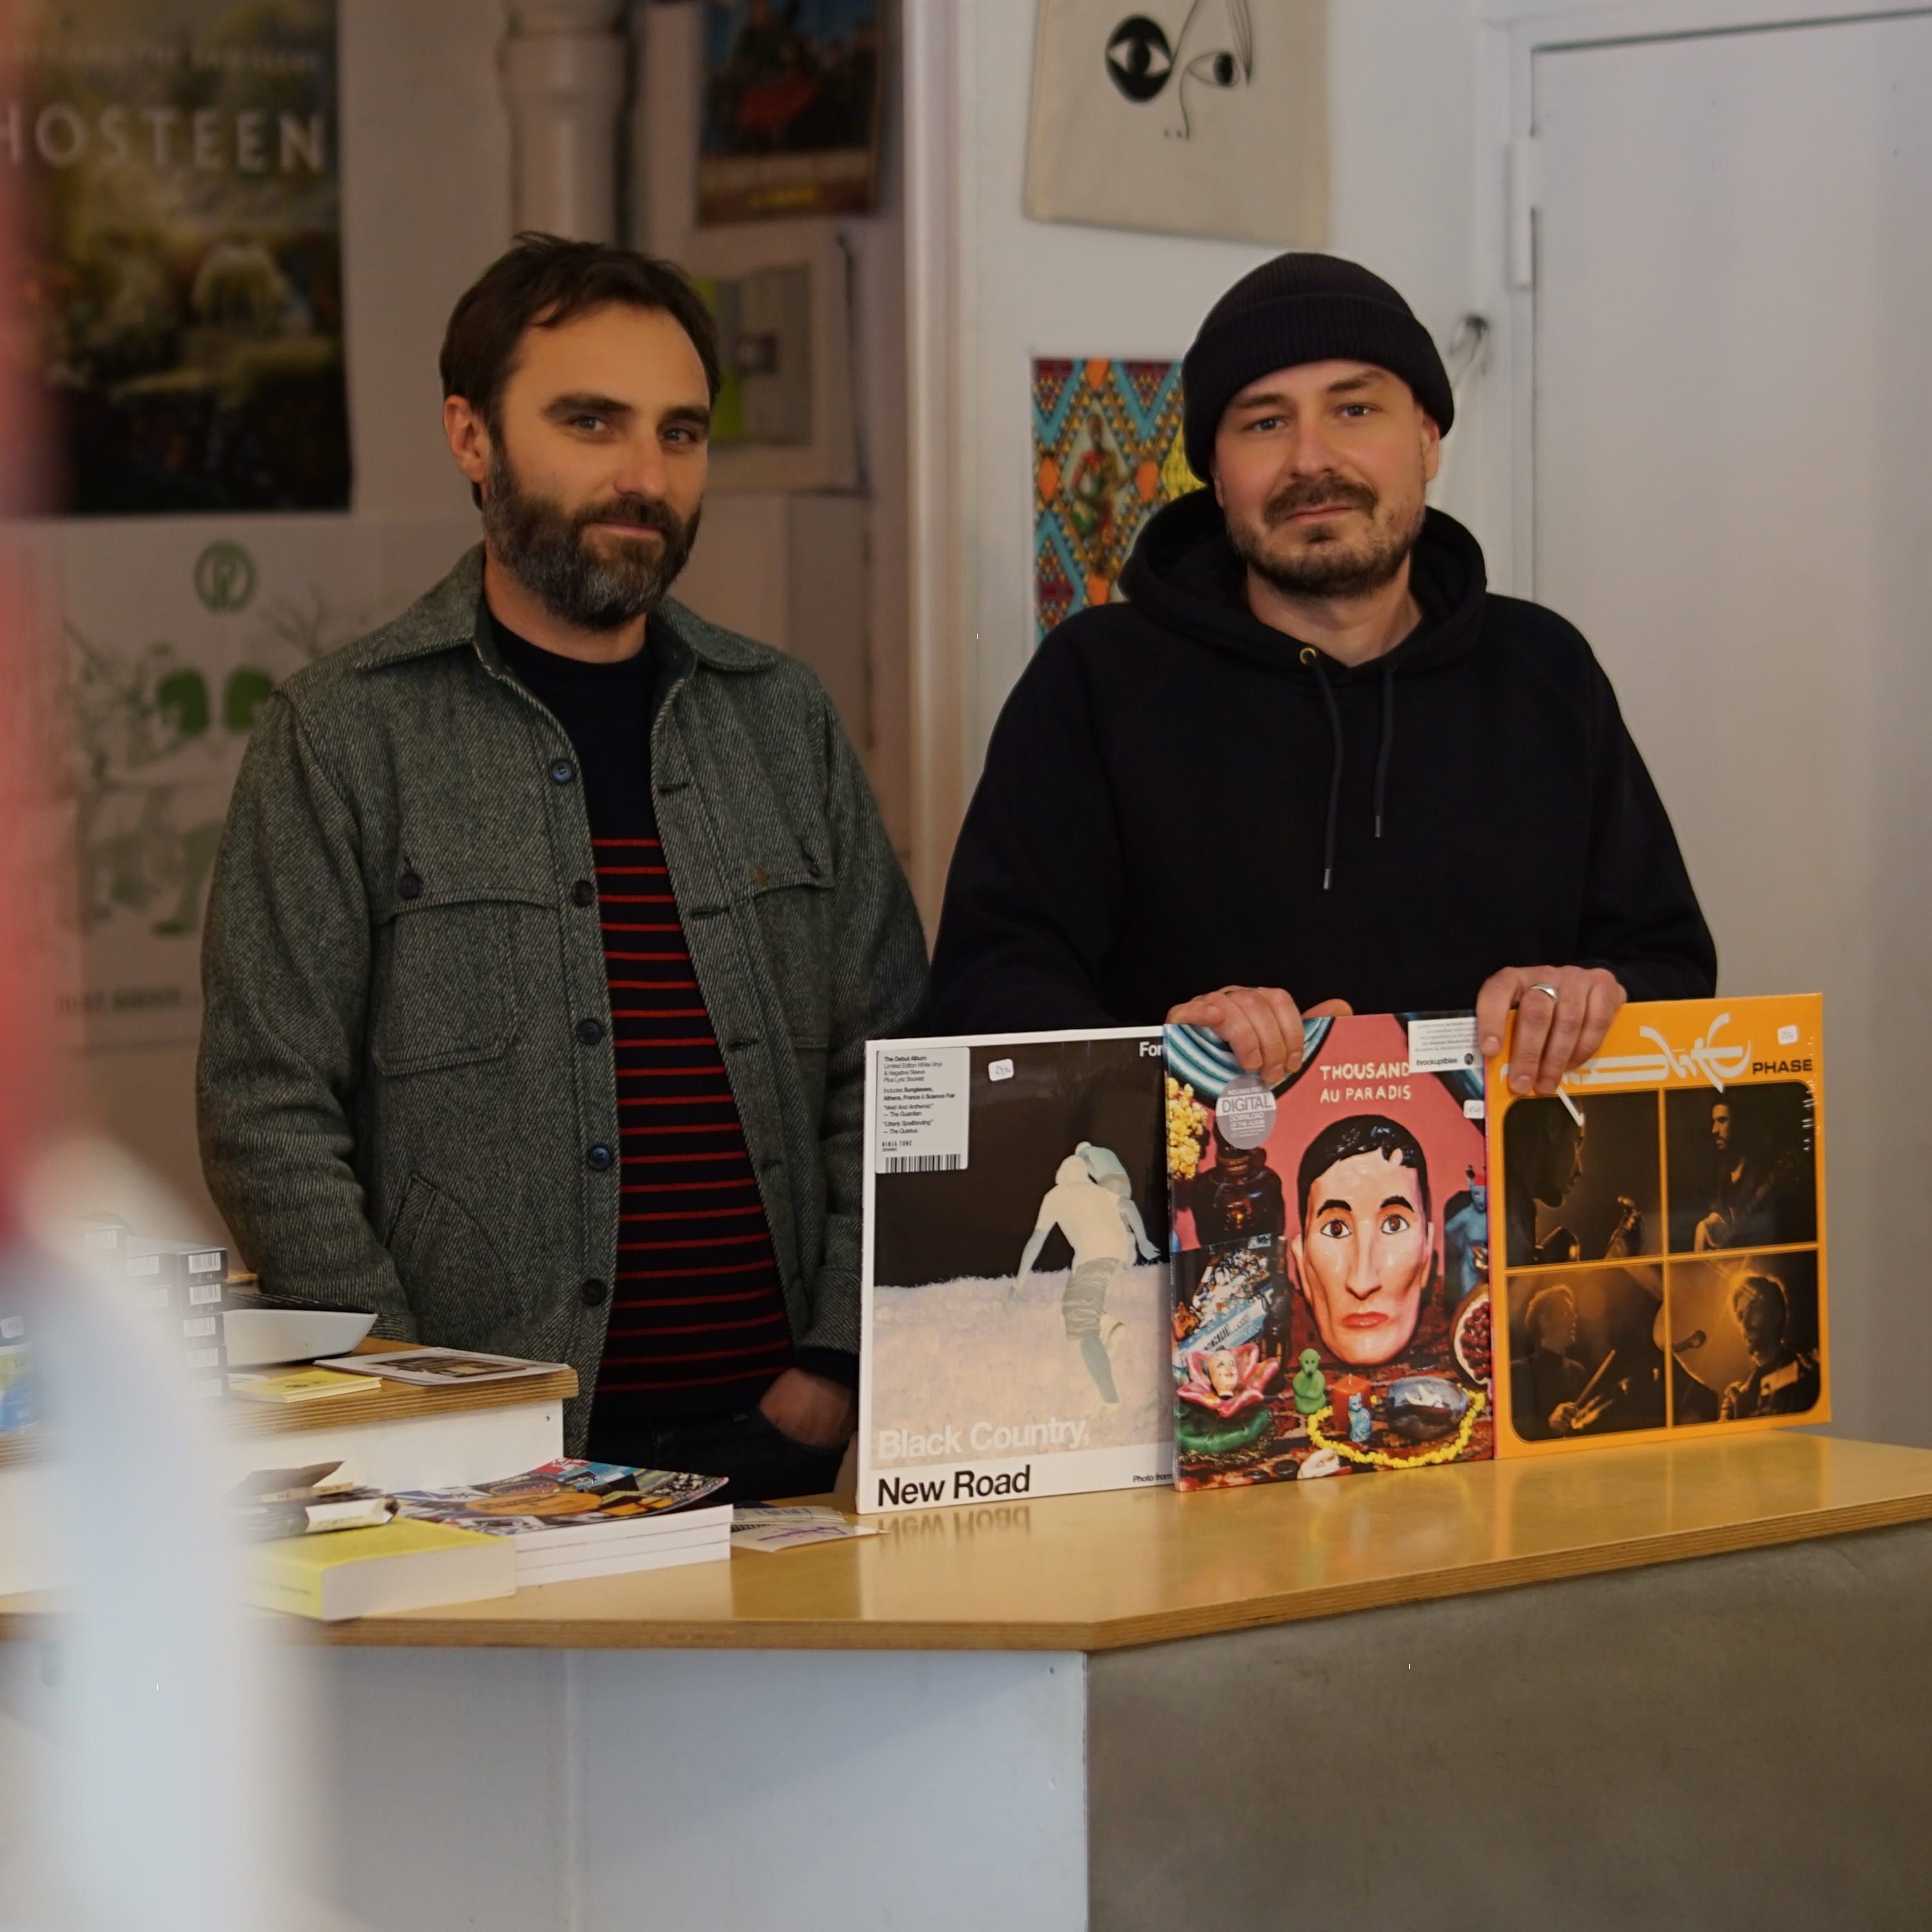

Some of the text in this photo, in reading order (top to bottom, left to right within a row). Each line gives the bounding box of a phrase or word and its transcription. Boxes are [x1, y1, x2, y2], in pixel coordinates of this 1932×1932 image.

[1320, 1061, 1410, 1081] THOUSAND
[1752, 1059, 1813, 1075] PHASE
[1320, 1084, 1411, 1103] AU PARADIS
[1222, 1095, 1273, 1113] DIGITAL
[878, 1416, 1090, 1461] Black Country,
[877, 1464, 1031, 1508] New Road
[1133, 1474, 1154, 1482] Photo
